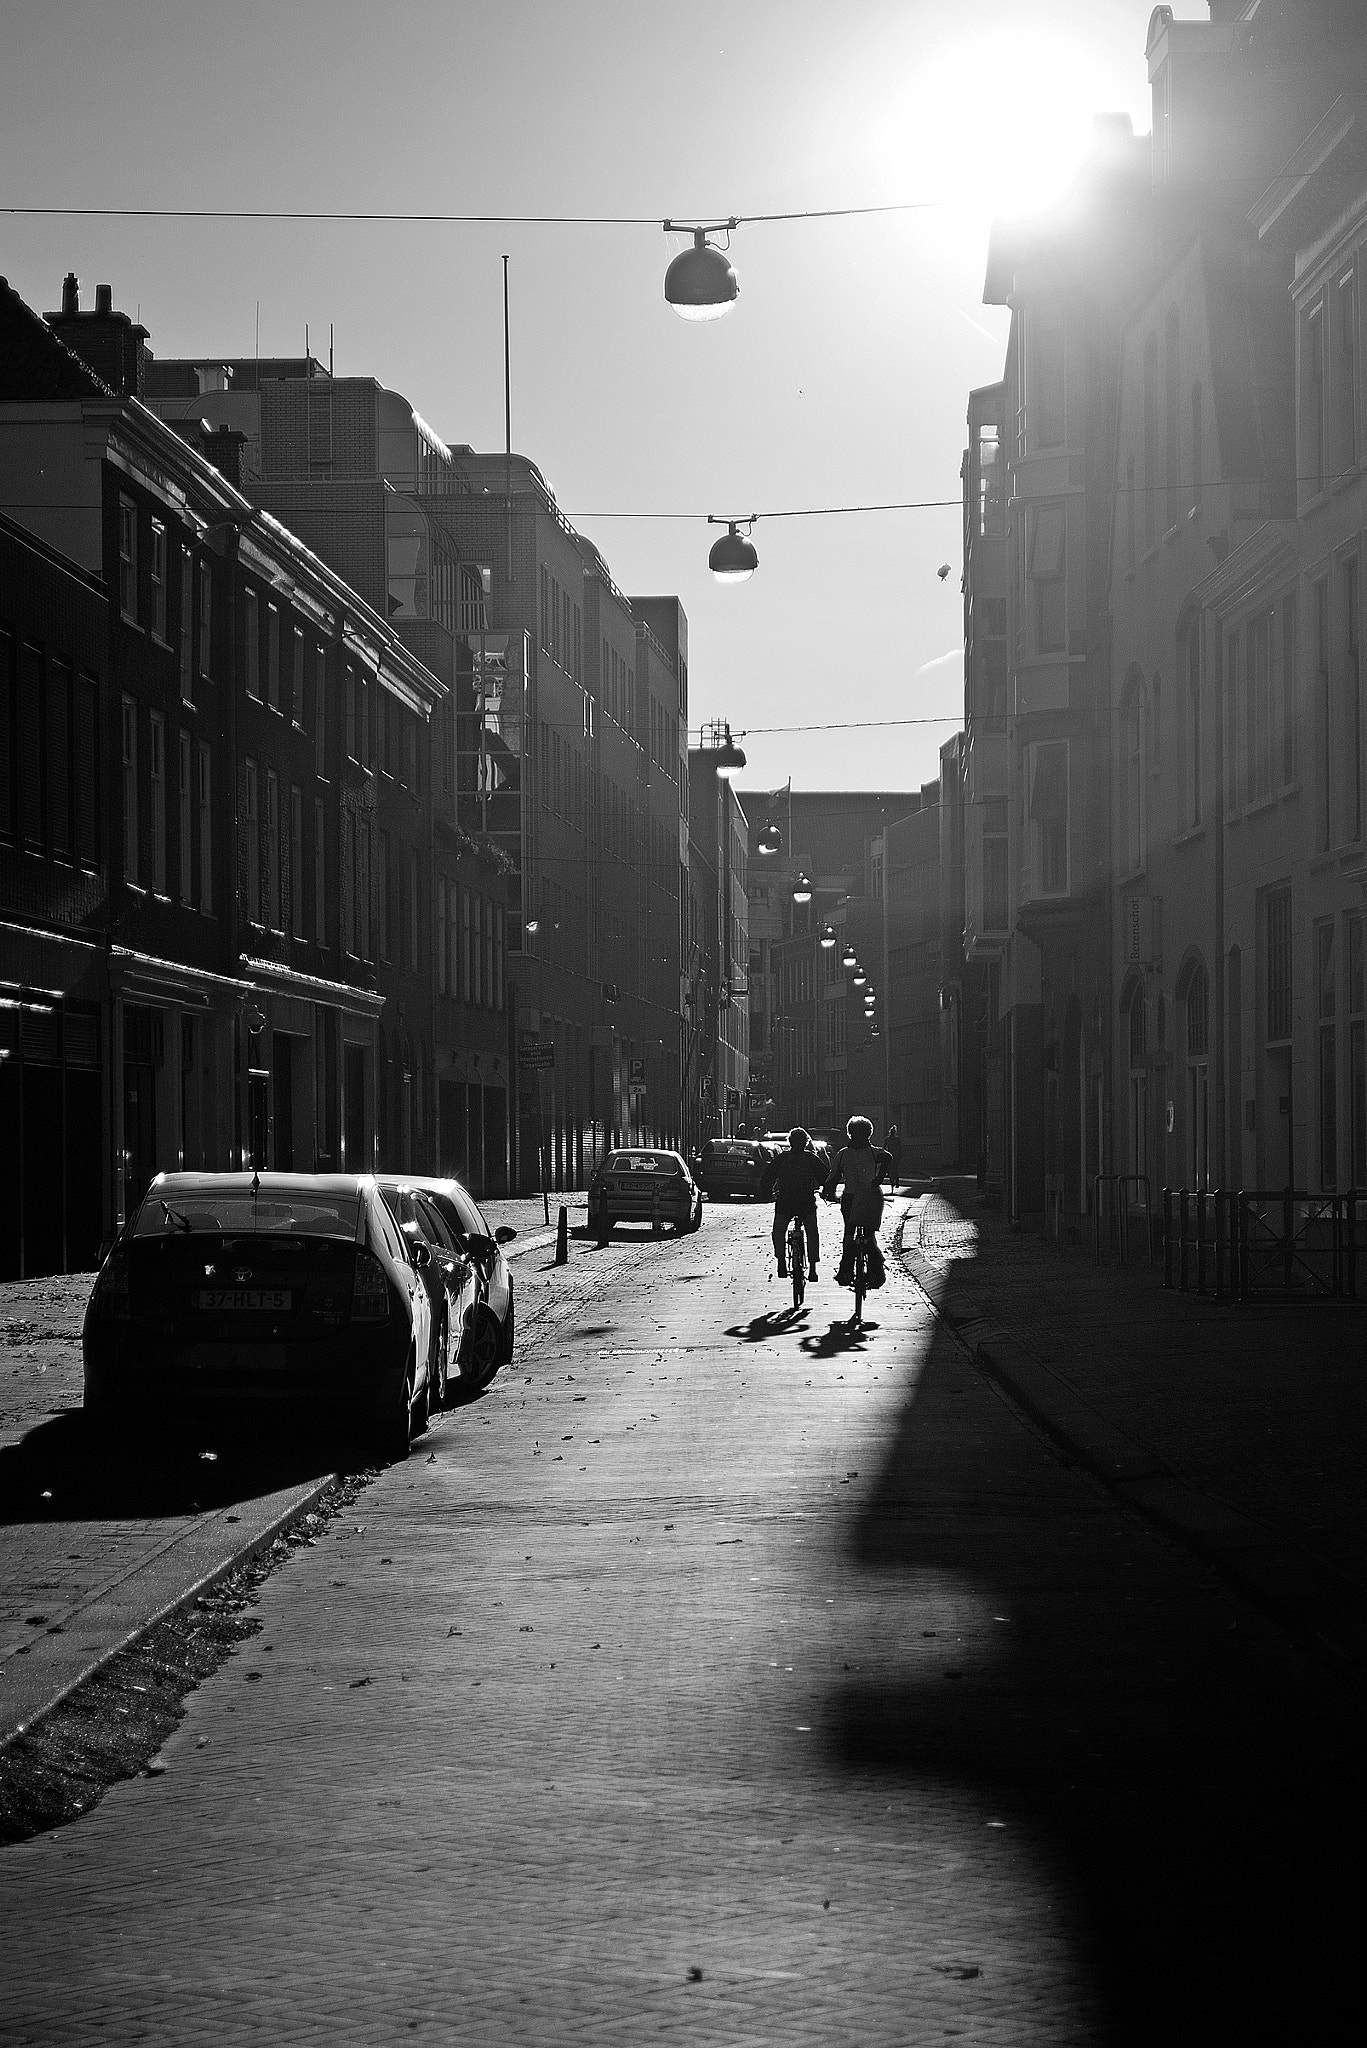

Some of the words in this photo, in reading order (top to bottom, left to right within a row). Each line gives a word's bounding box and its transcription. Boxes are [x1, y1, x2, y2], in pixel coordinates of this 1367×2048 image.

[1130, 898, 1140, 959] Berenschot
[632, 1060, 643, 1074] P
[703, 1078, 711, 1090] P
[206, 1292, 284, 1308] 37-HLT-5
